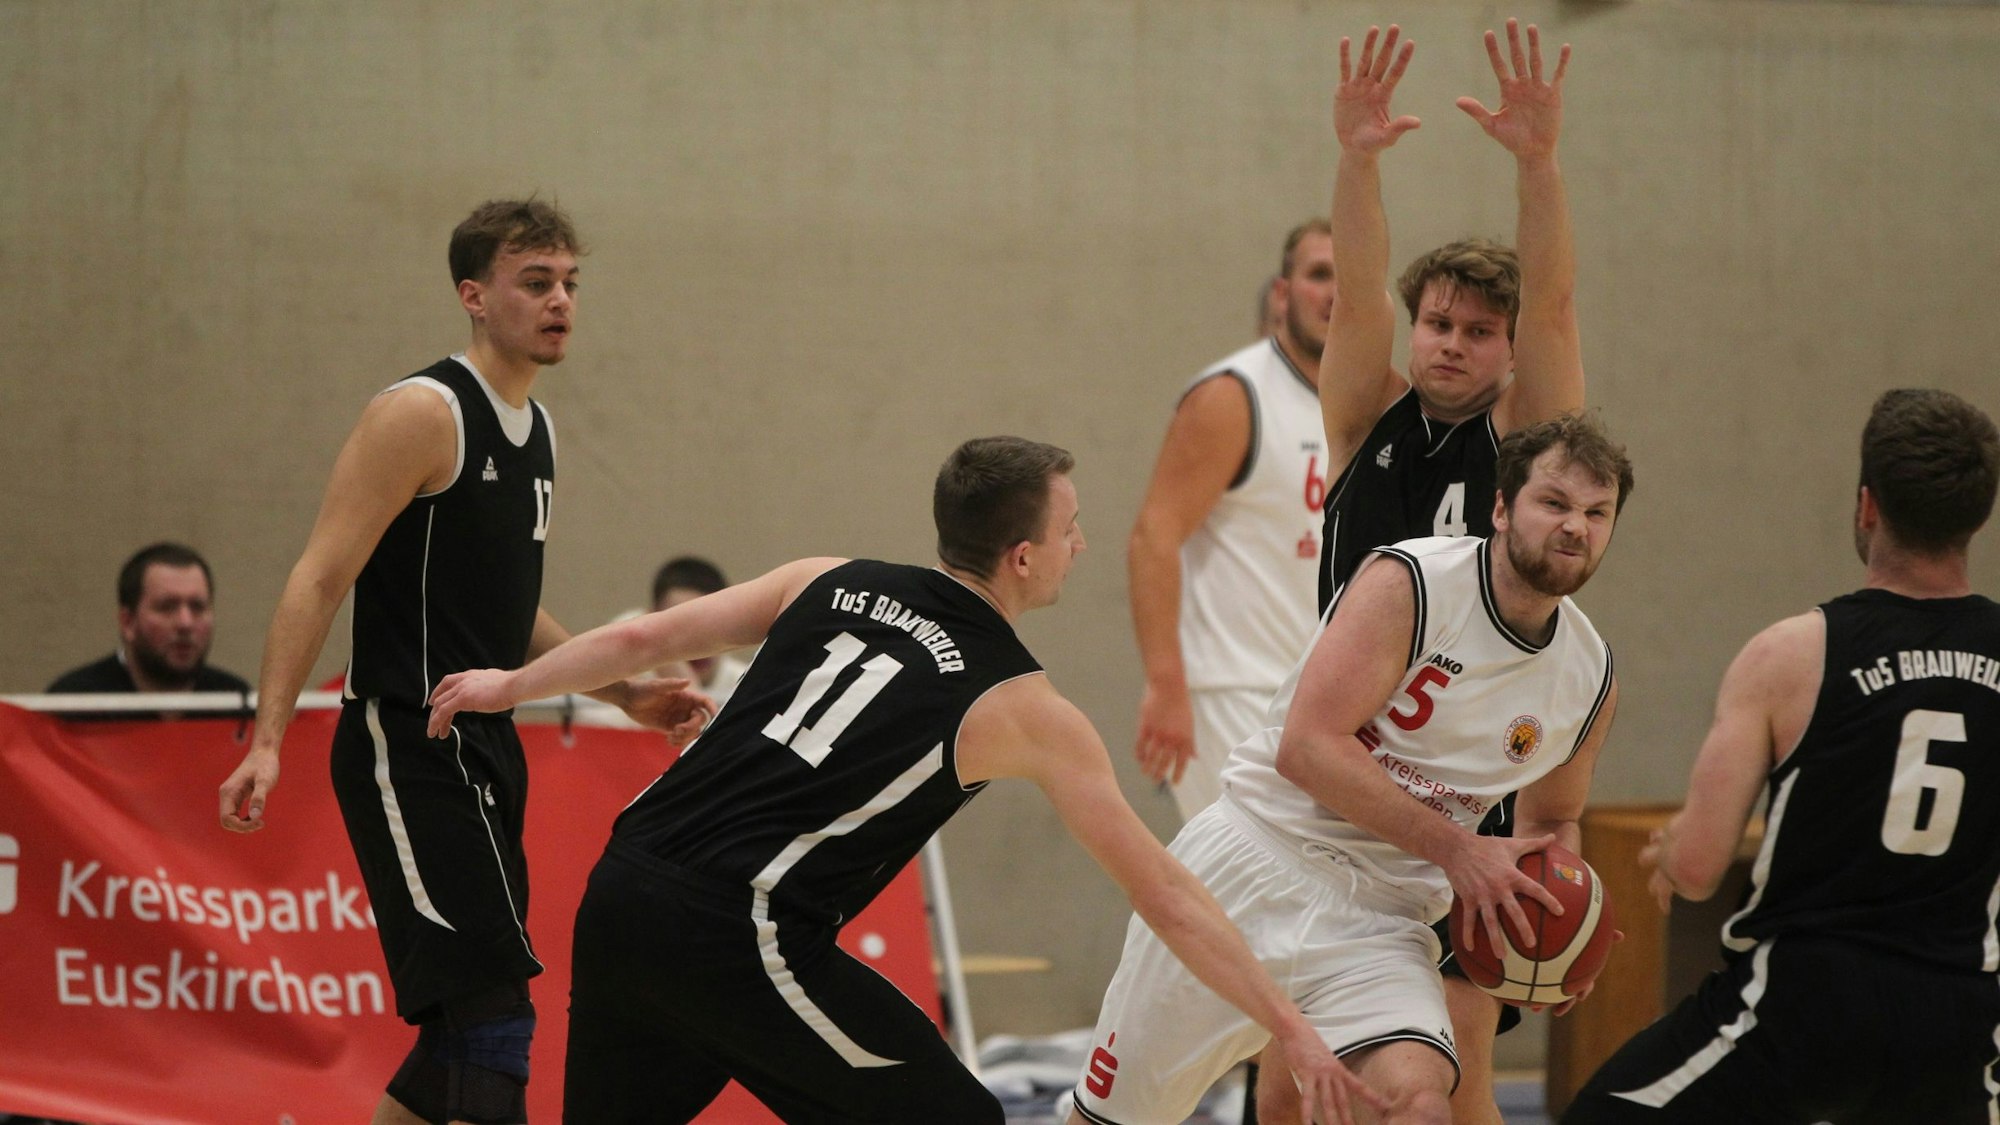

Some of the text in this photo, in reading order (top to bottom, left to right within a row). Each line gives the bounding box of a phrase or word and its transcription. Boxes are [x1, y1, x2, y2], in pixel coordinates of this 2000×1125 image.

[1304, 455, 1326, 513] 6
[1432, 481, 1468, 537] 4
[831, 588, 870, 615] TuS
[1427, 653, 1463, 675] AKO
[1850, 650, 2000, 696] TuS BRAUWEIL
[761, 631, 904, 769] 11
[1387, 665, 1451, 731] 5
[1881, 708, 1968, 857] 6
[54, 947, 386, 1017] Euskirchen
